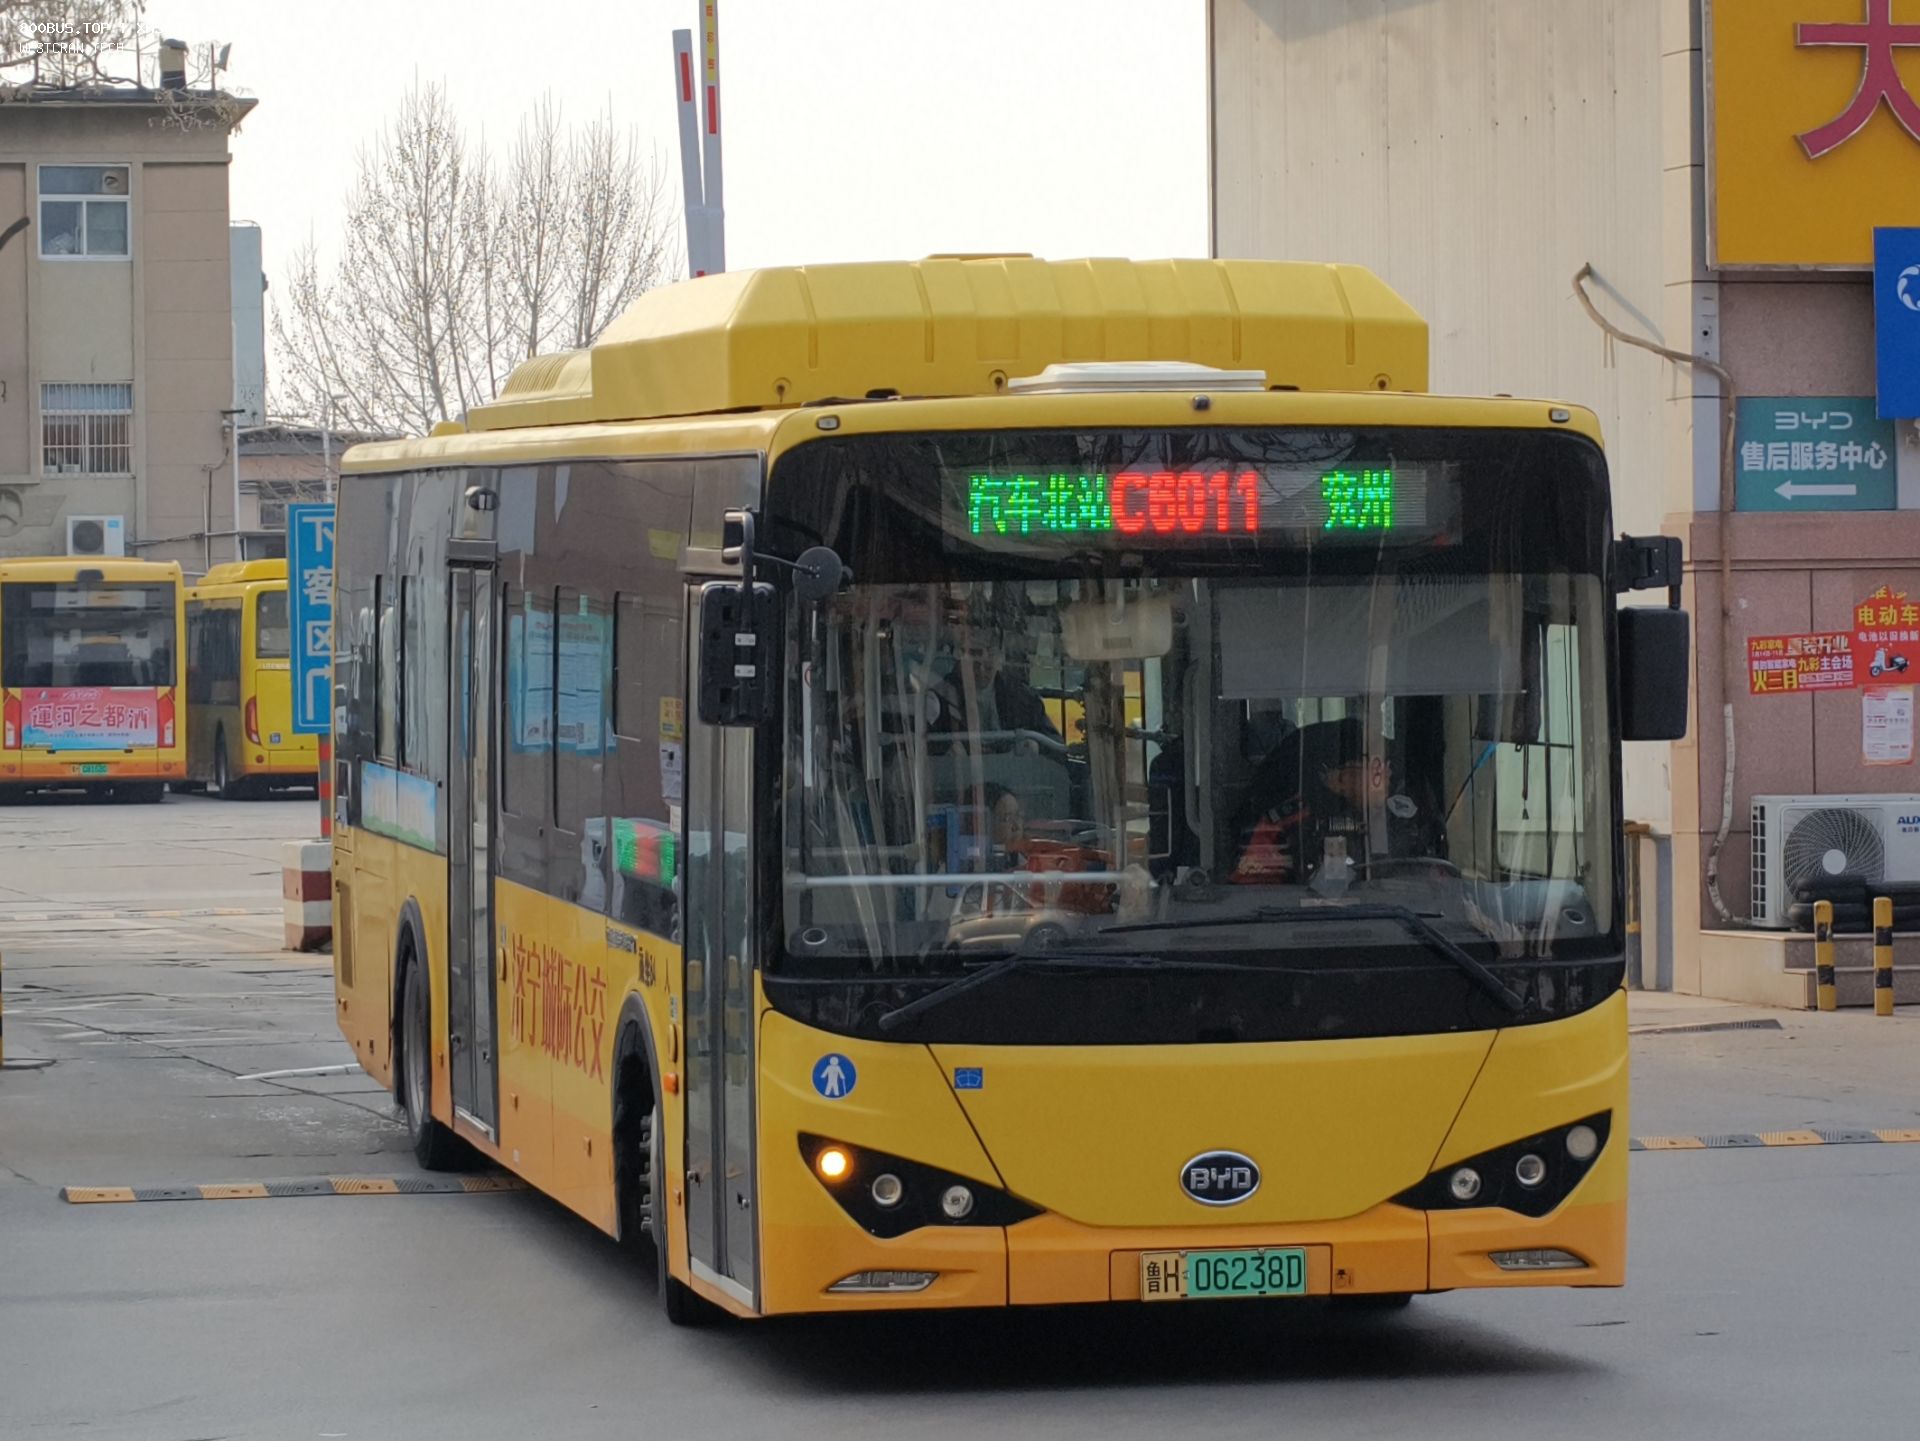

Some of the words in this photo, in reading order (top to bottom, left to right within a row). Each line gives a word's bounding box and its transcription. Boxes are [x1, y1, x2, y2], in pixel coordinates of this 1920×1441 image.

[1775, 411, 1853, 430] BYD
[1741, 441, 1887, 472] 售后服务中心
[1322, 468, 1393, 531] 兖州
[302, 516, 335, 656] 下客区
[1858, 604, 1919, 626] 电动车
[511, 933, 607, 1084] 济宁城际公交
[1190, 1167, 1251, 1190] BYD
